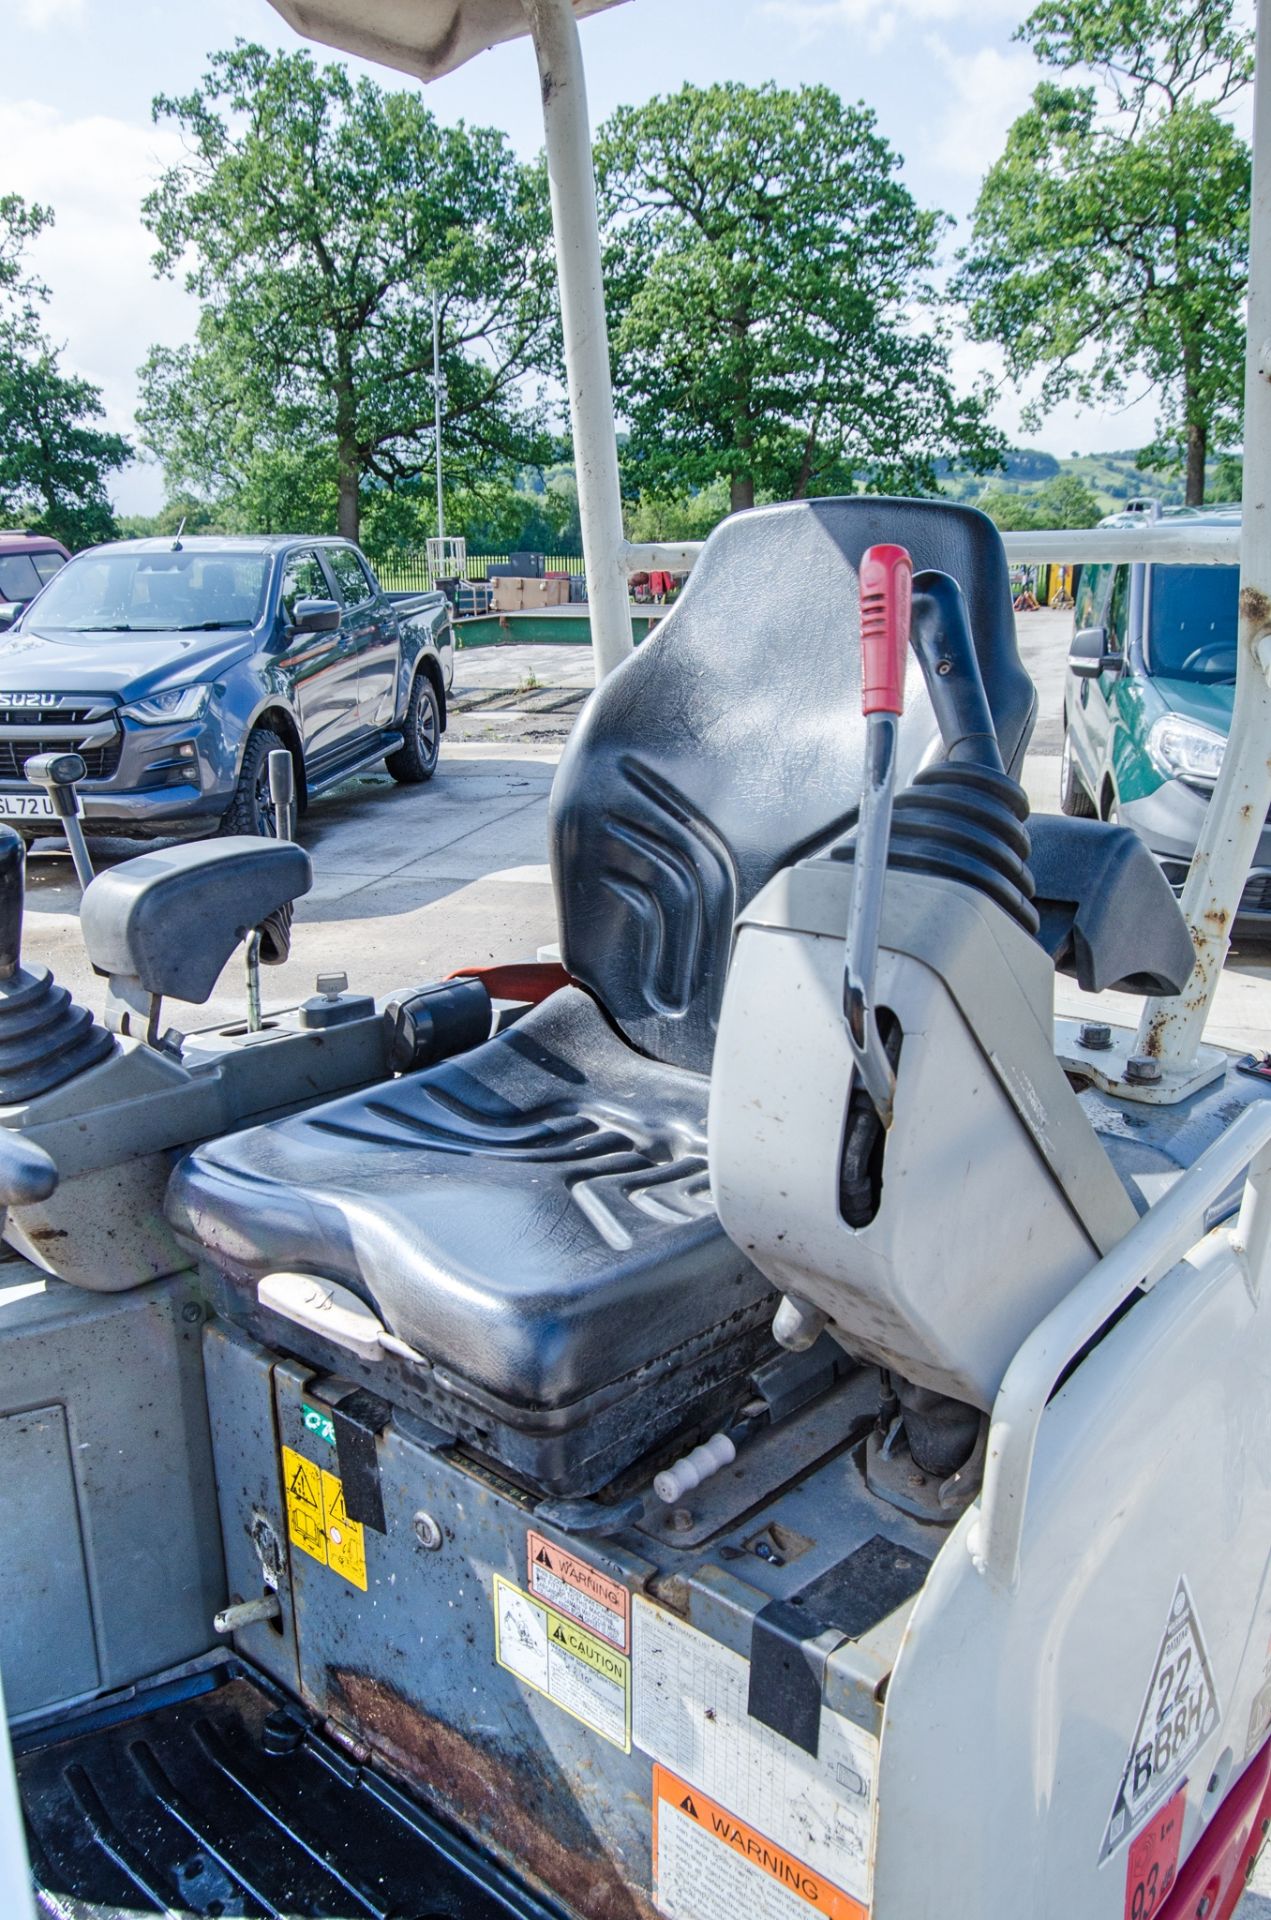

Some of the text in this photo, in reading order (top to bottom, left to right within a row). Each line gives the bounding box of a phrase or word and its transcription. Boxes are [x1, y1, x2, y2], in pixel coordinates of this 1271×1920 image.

[0, 694, 56, 707] SUZU
[559, 1560, 619, 1605] WARNING
[569, 1635, 622, 1679] CAUTION
[1156, 1646, 1192, 1725] 22
[711, 1812, 818, 1900] WARNING
[1131, 1862, 1160, 1920] 93
